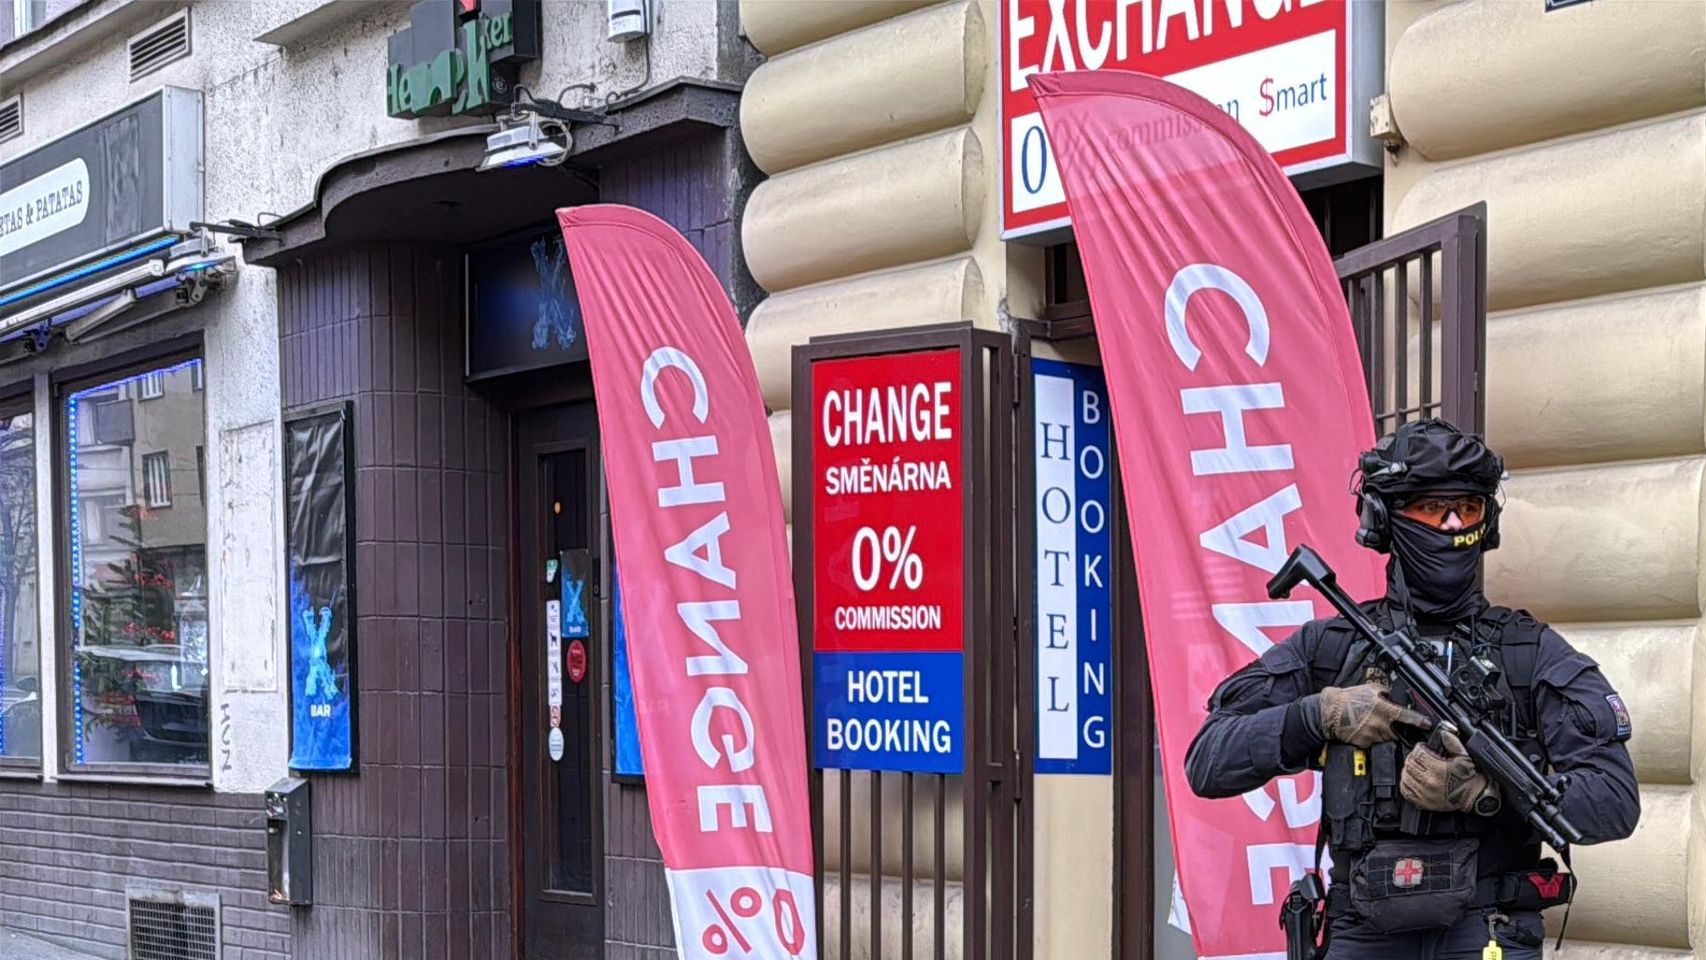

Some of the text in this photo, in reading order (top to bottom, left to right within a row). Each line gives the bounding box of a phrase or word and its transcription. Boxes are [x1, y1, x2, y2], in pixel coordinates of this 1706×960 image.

[26, 203, 34, 225] &
[36, 180, 83, 221] PATATAS
[822, 381, 953, 448] CHANGE
[825, 456, 952, 495] SMĚNÁRNA
[851, 526, 923, 592] 0%
[1040, 423, 1071, 713] HOTEL
[1080, 389, 1106, 749] BOOKING
[835, 605, 941, 631] COMMISSION
[848, 669, 929, 705] HOTEL
[311, 704, 331, 718] BAR
[826, 717, 952, 754] BOOKING
